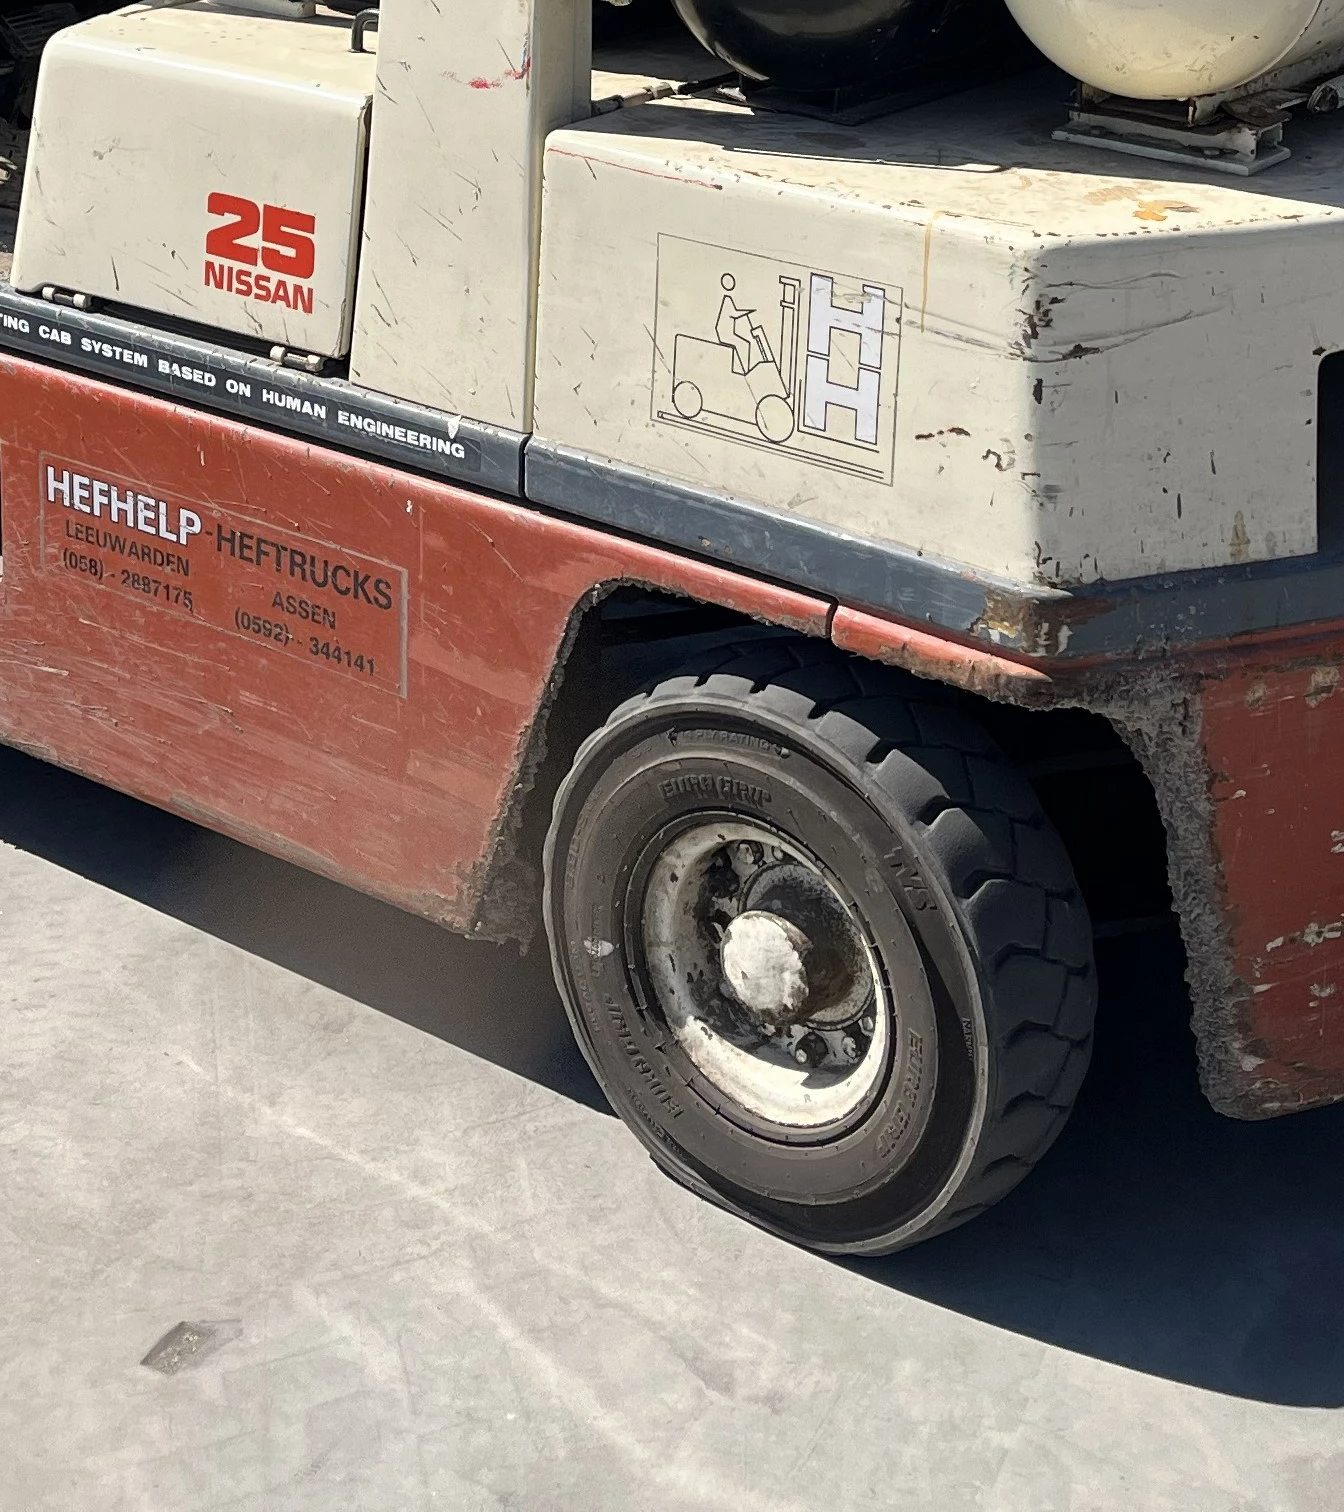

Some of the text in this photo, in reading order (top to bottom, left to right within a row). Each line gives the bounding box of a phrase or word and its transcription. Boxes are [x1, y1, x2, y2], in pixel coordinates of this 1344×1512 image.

[206, 193, 316, 278] 25
[204, 262, 314, 314] NISSAN
[38, 323, 72, 345] CAB
[81, 337, 148, 368] SYSTEM
[157, 356, 217, 389] BASED
[225, 377, 252, 398] ON
[261, 387, 327, 421] HUMAN
[337, 411, 466, 459] ENGINEERING
[63, 547, 105, 581] (058)
[121, 569, 193, 612] 2887175
[65, 519, 190, 577] LEEUWARDEN
[235, 608, 290, 646] (0592)
[309, 638, 374, 676] 344141
[272, 591, 336, 629] ASSEN
